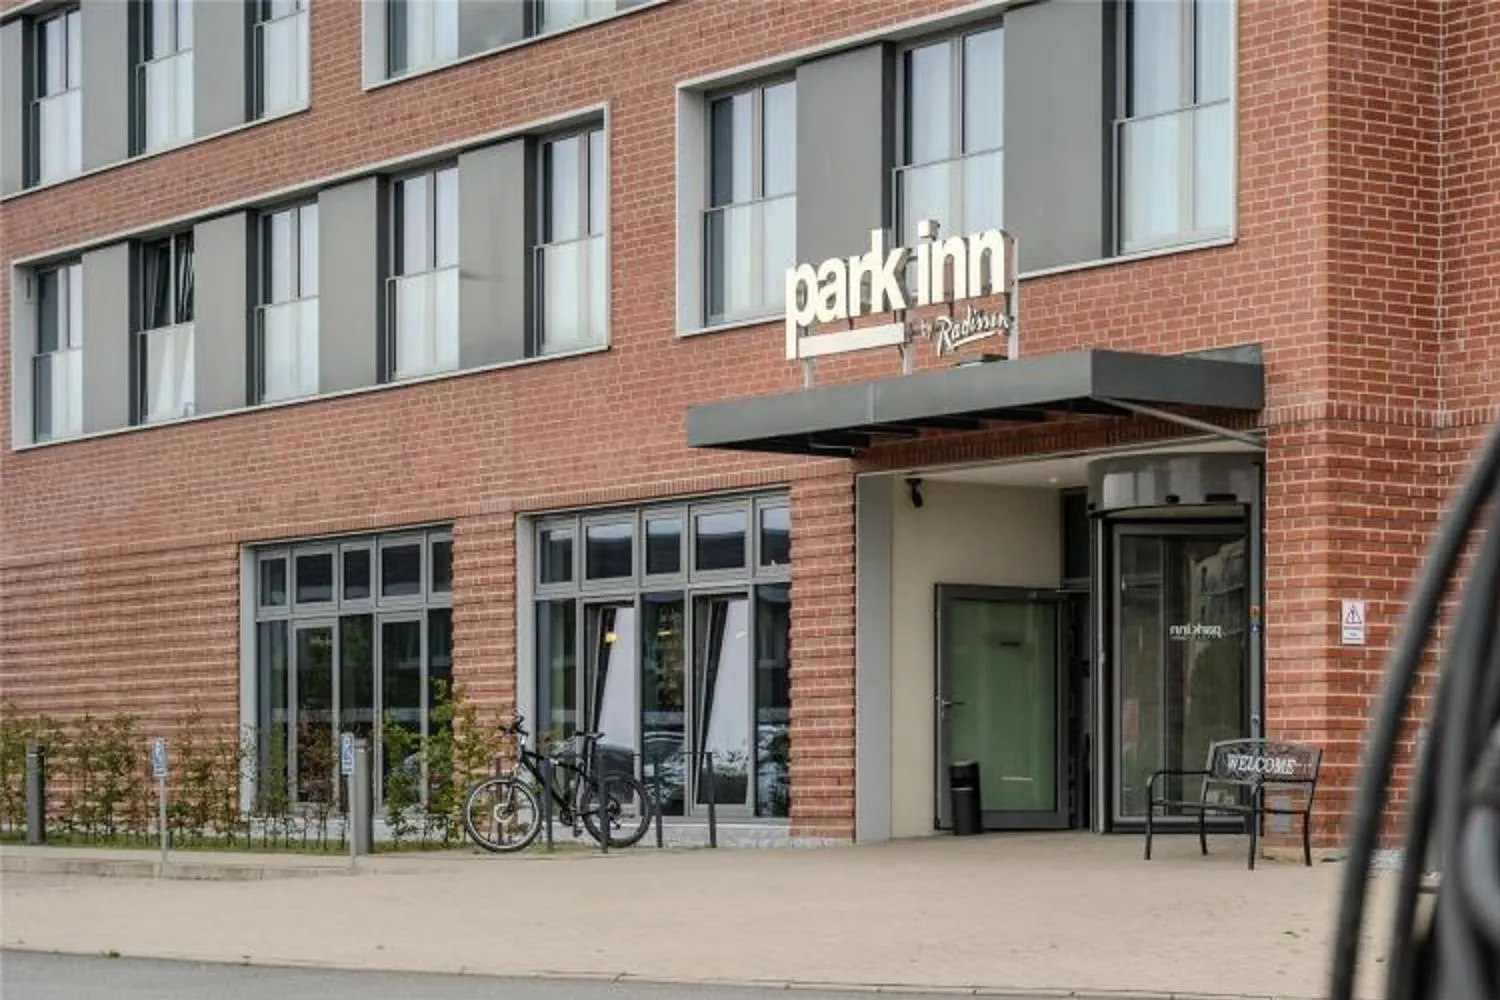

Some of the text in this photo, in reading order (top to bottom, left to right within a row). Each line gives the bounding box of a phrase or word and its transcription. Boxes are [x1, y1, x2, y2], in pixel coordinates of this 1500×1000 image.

[786, 219, 1006, 359] park inn
[1227, 753, 1296, 775] WELCOME
